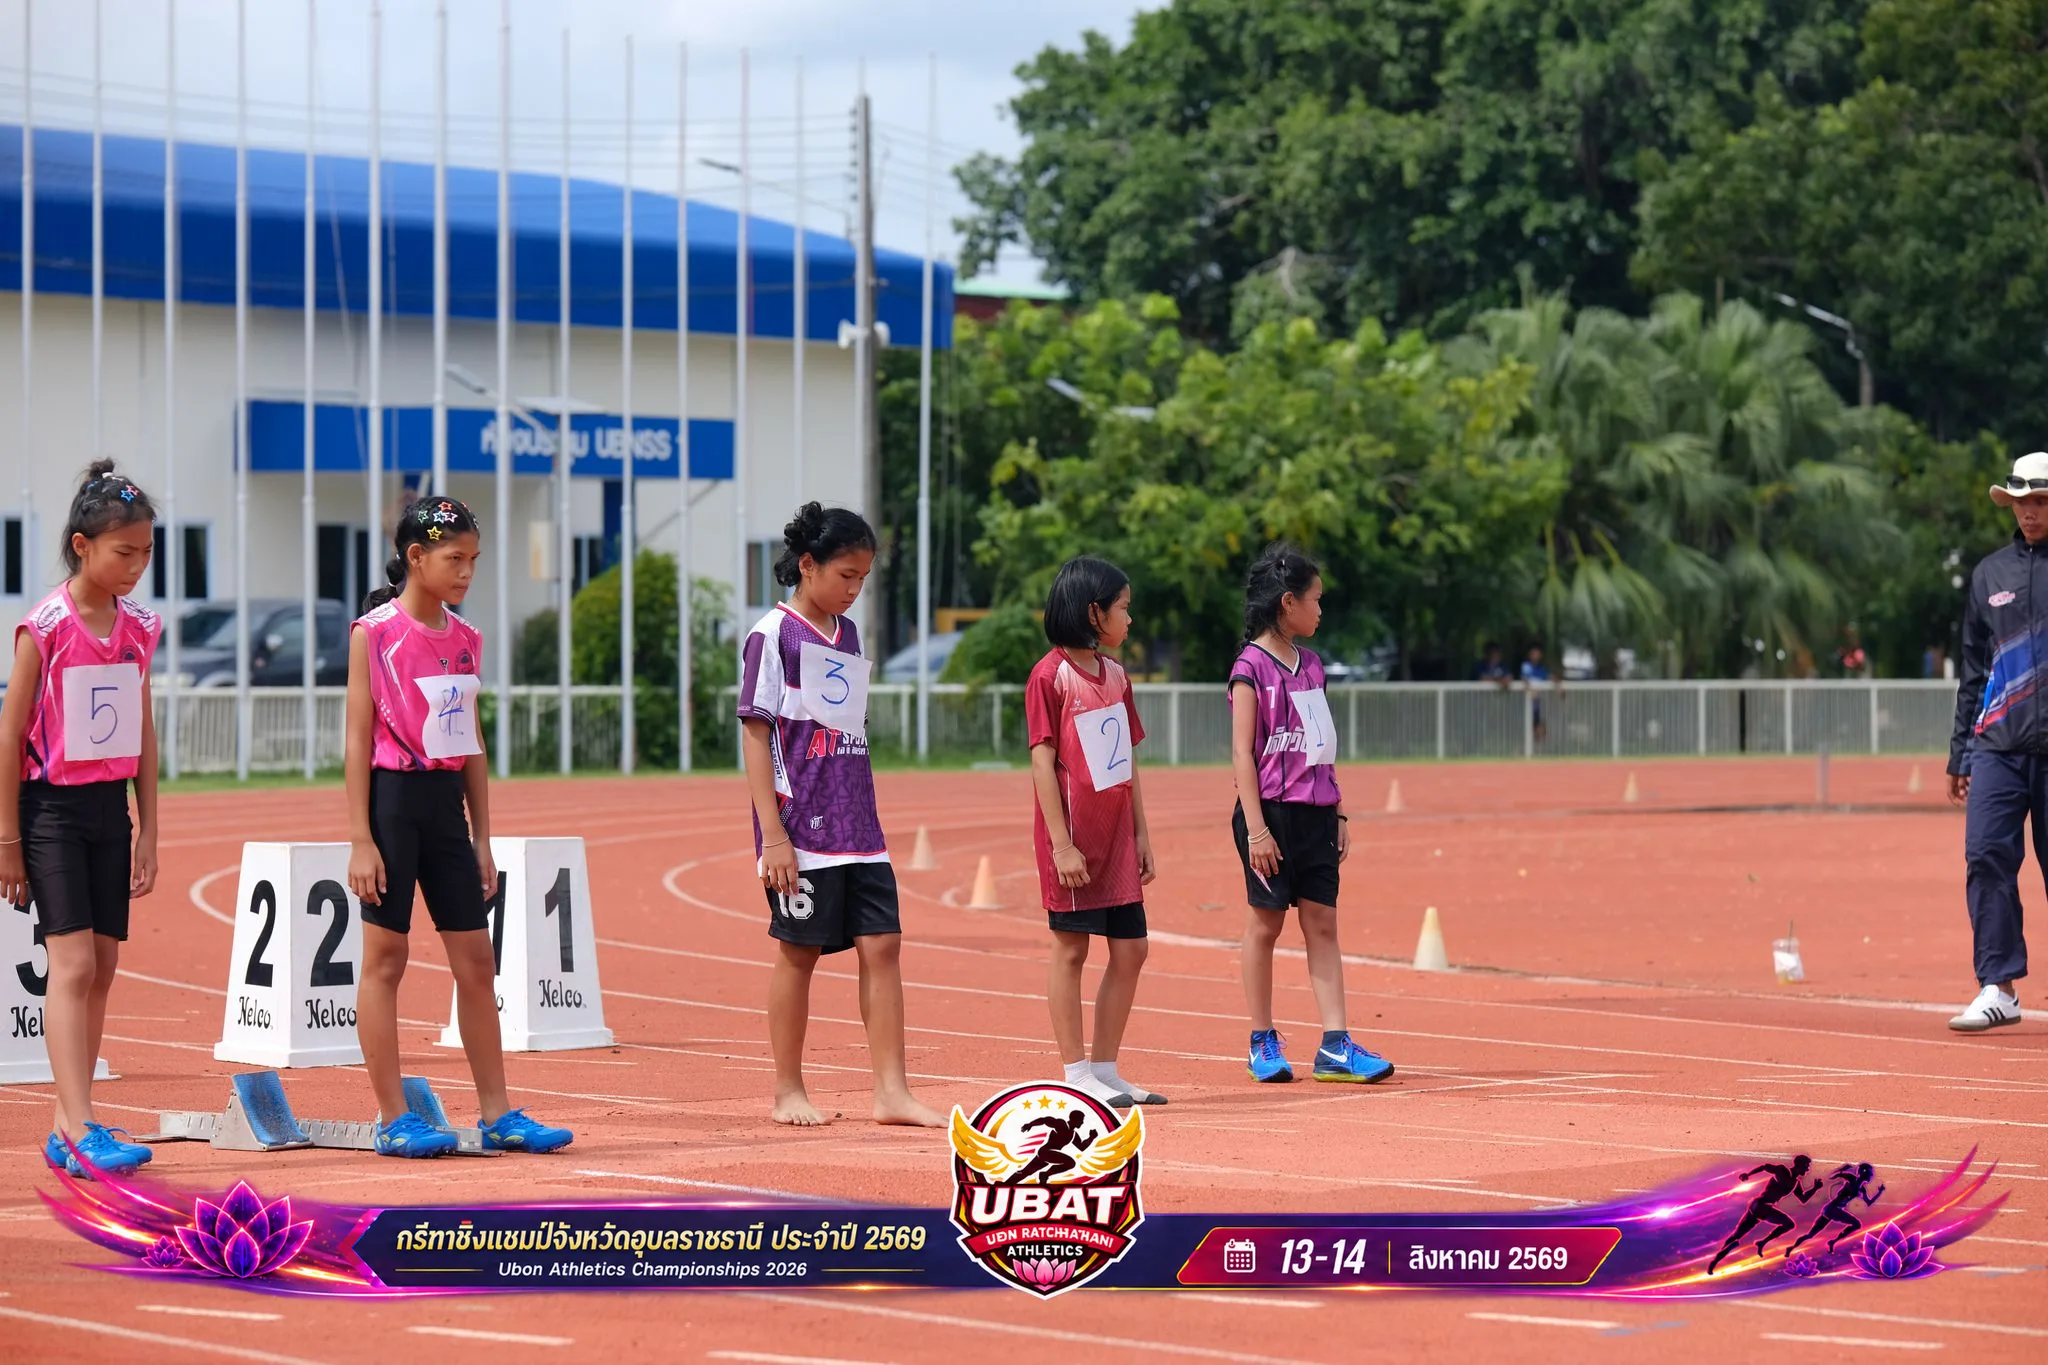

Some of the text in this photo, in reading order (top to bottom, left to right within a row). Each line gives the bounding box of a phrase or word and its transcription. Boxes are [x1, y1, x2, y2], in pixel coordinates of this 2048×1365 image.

[820, 657, 850, 705] 3
[1266, 685, 1276, 709] 7
[89, 686, 119, 745] 5
[438, 686, 464, 737] 4
[1307, 703, 1325, 748] 1
[805, 727, 842, 760] AT
[1100, 717, 1128, 770] 2
[545, 867, 574, 973] 1
[777, 877, 815, 920] 16
[245, 879, 277, 988] 2
[306, 879, 354, 988] 2
[484, 870, 507, 976] 1
[237, 996, 272, 1030] Nelco
[305, 998, 357, 1030] Nelco
[539, 979, 583, 1009] Nelco
[10, 1005, 45, 1038] Nel
